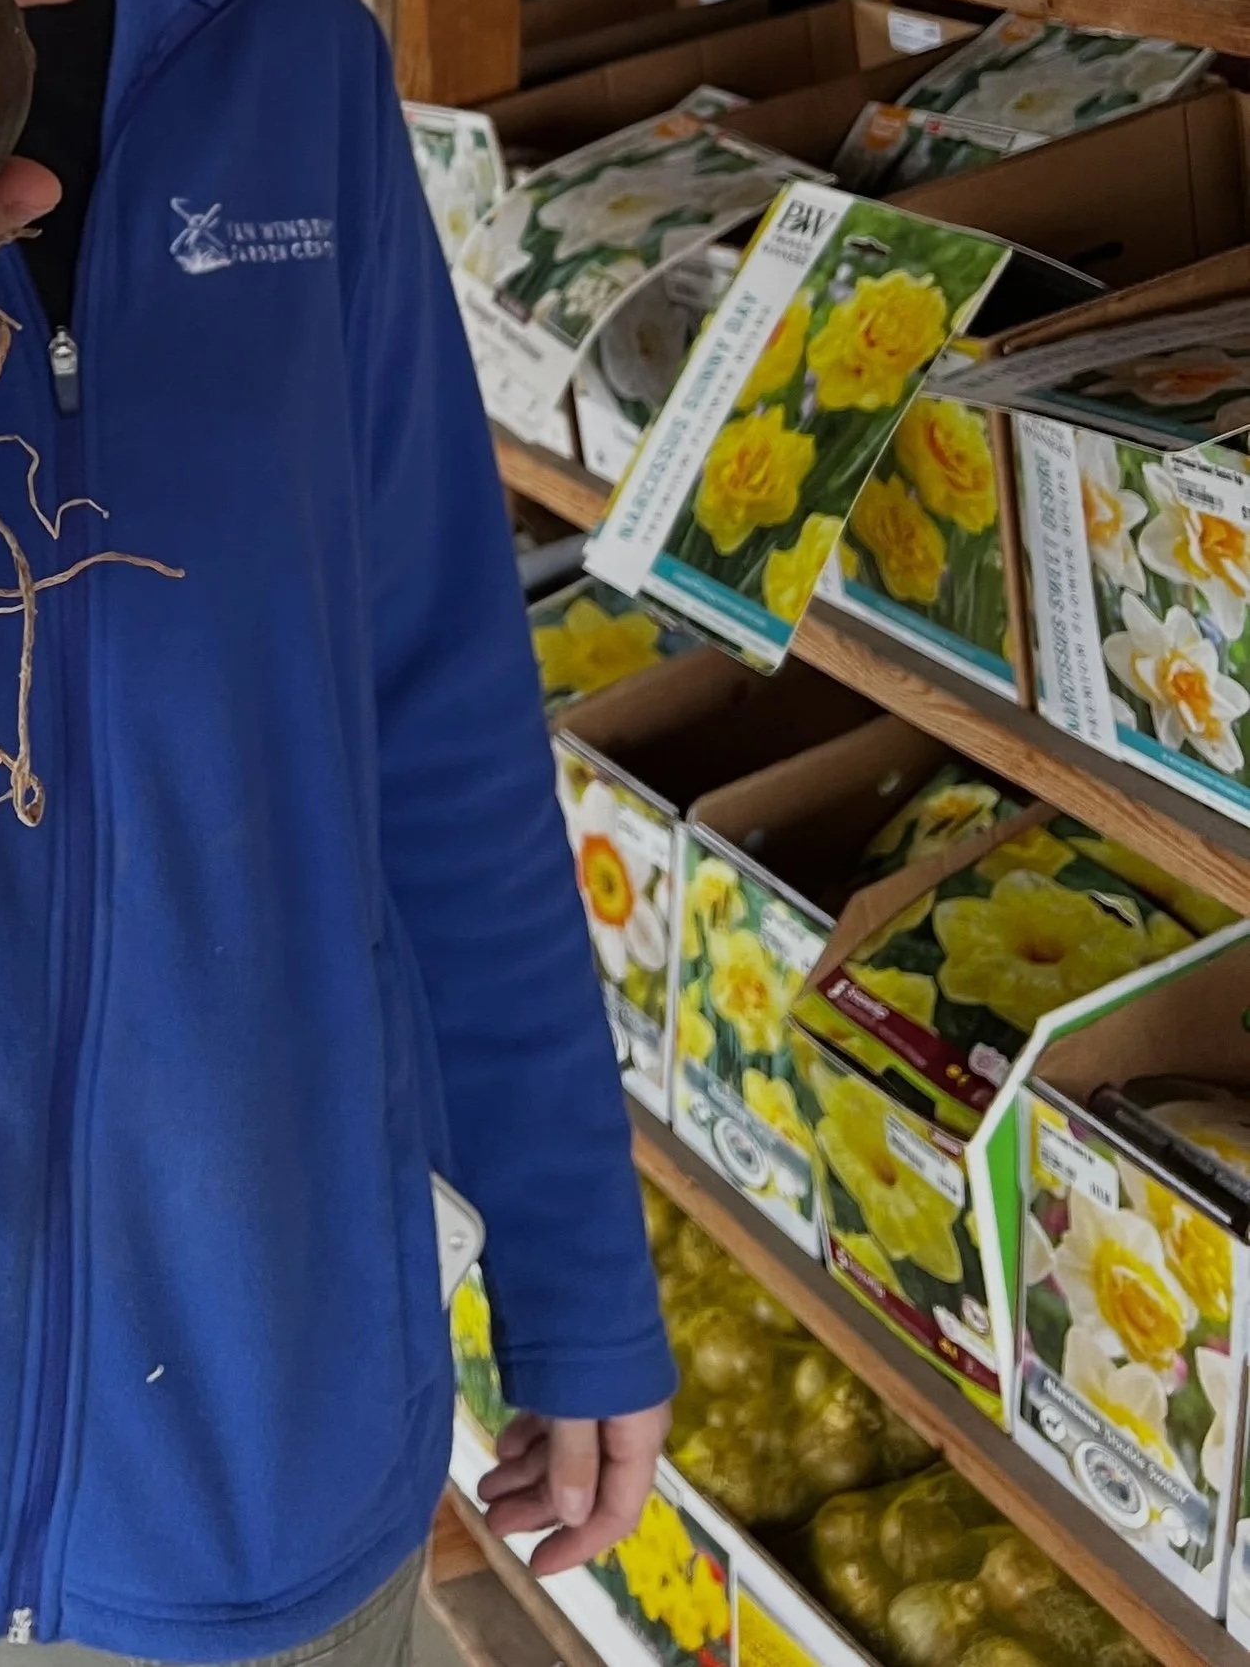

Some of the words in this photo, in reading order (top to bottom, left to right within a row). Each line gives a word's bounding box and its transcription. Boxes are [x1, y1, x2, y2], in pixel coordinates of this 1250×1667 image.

[617, 415, 690, 543] NARCISSUS
[682, 336, 731, 413] SUNNY
[724, 289, 758, 335] DAY
[1042, 536, 1066, 614] SWEET
[1048, 613, 1083, 734] NARCISSUS
